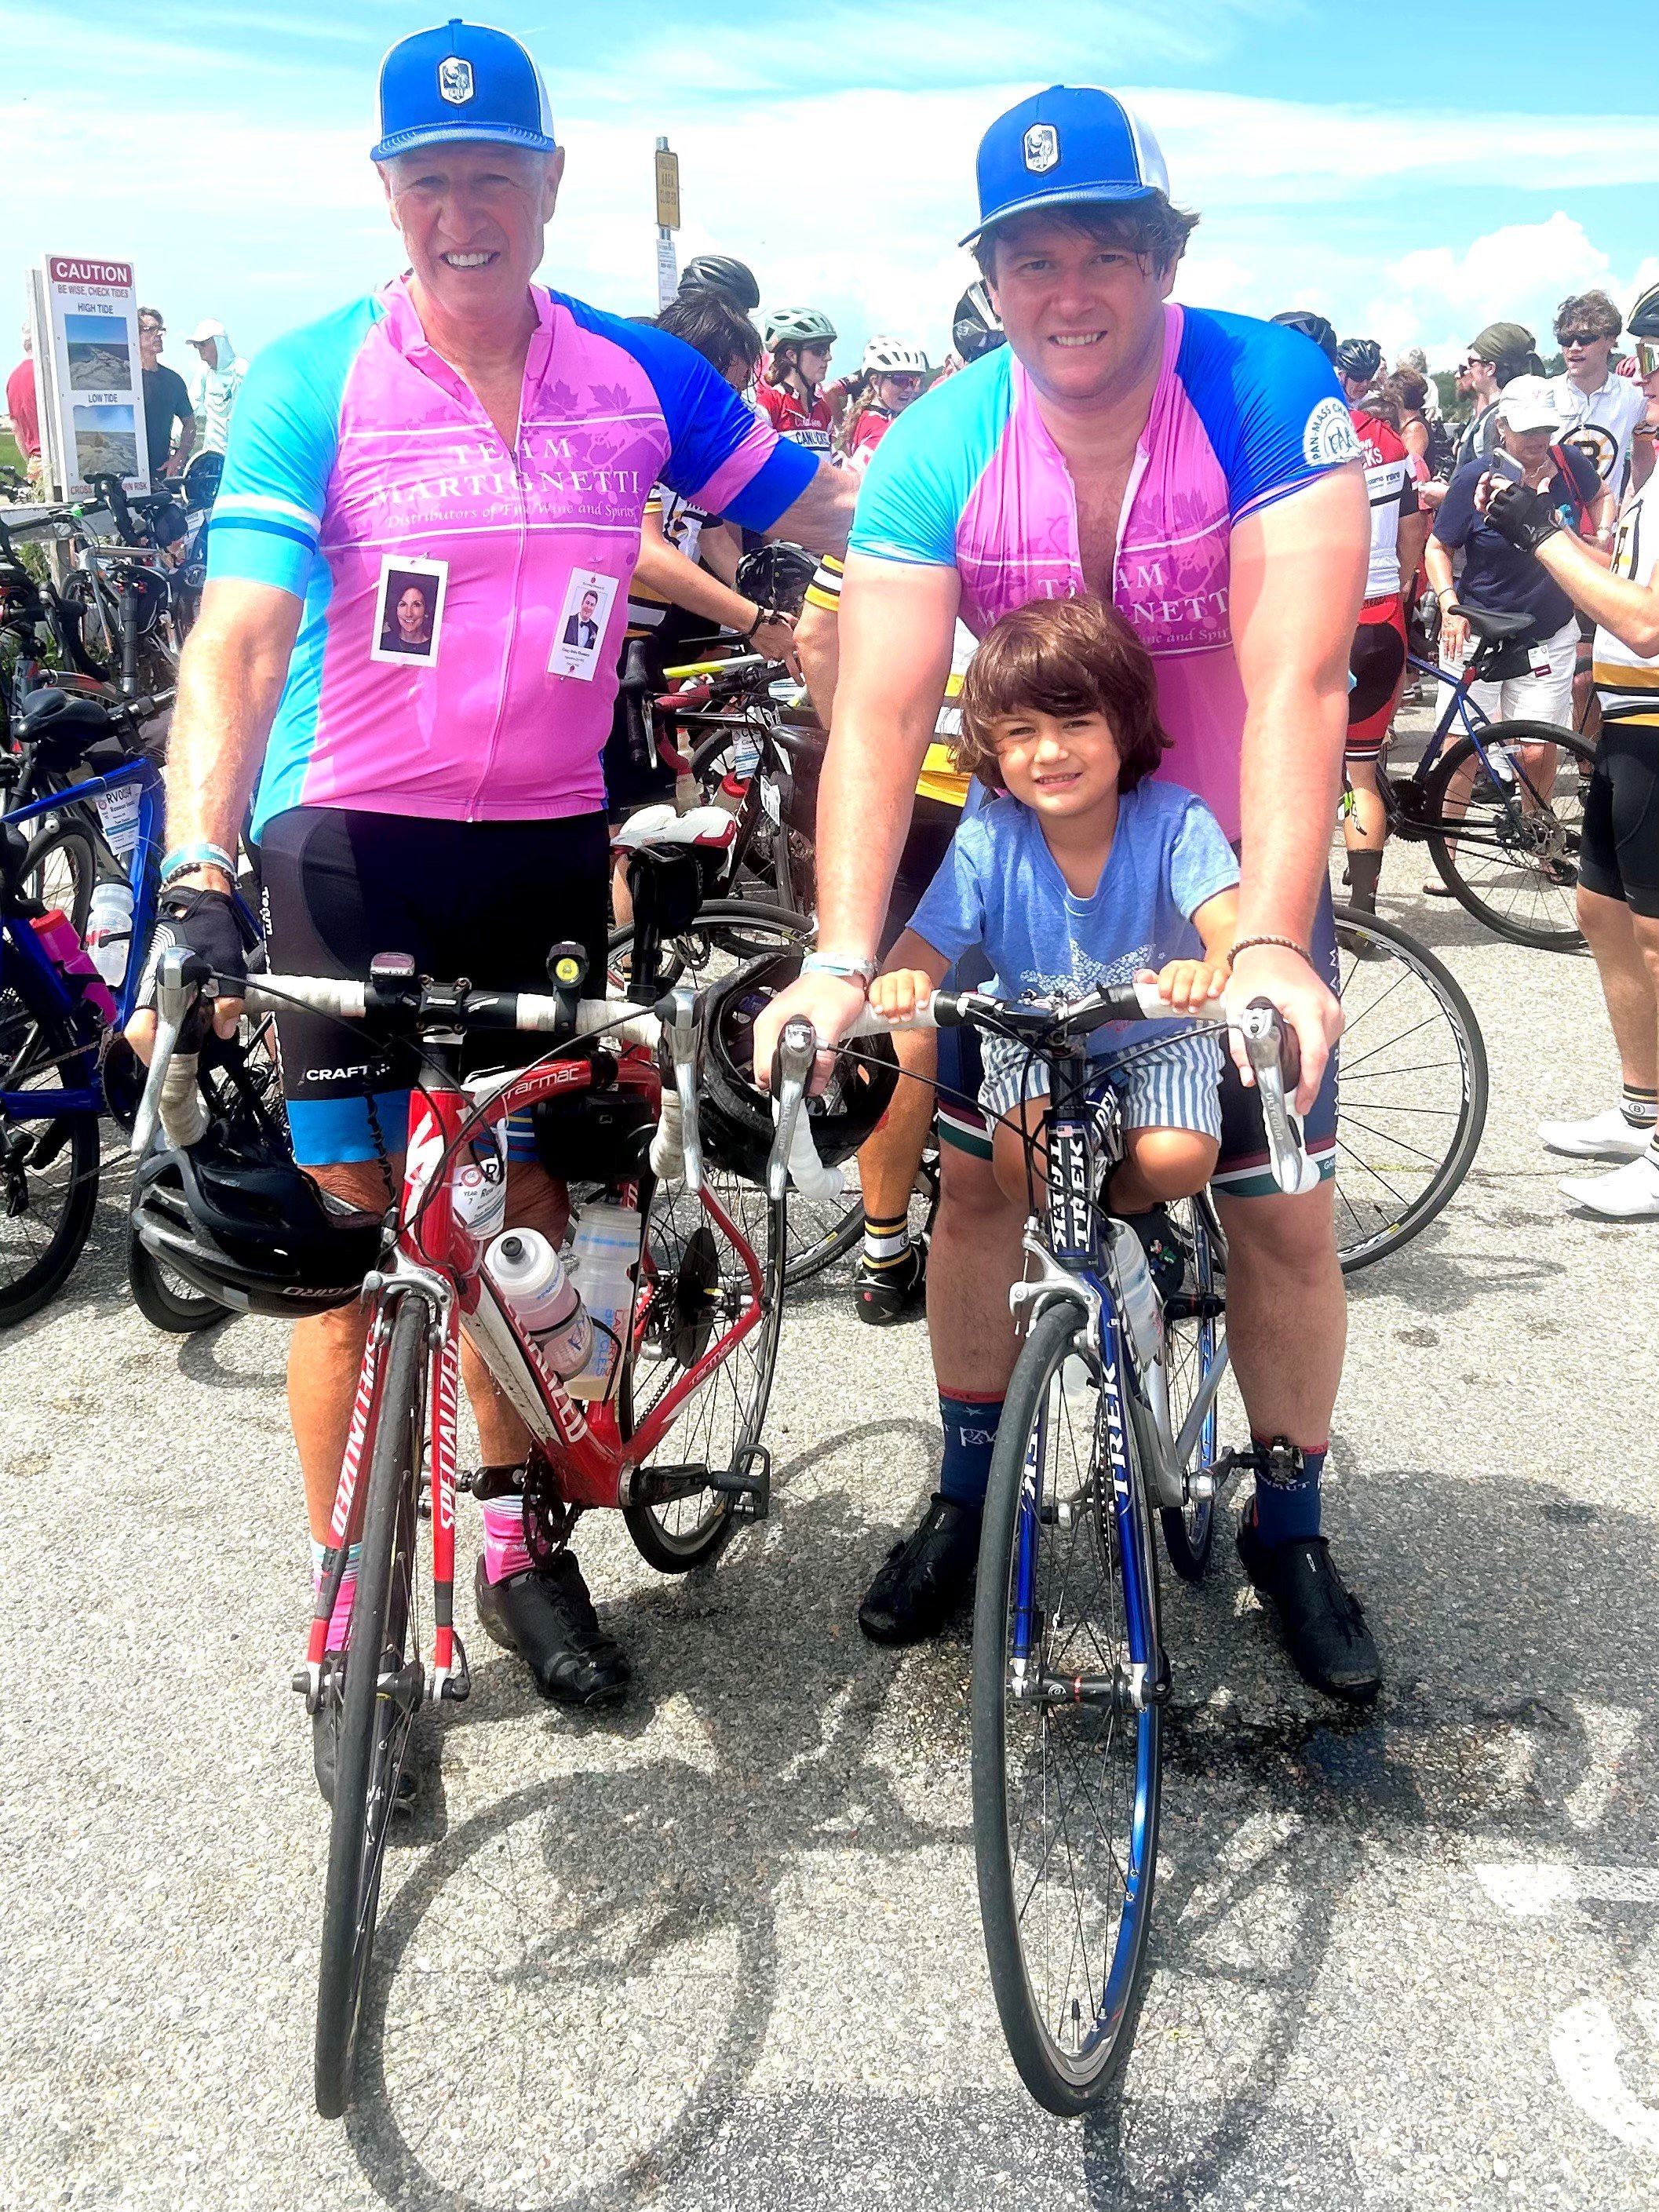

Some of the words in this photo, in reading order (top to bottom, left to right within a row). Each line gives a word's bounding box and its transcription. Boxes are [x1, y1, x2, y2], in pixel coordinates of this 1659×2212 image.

[56, 261, 128, 282] CAUTION
[57, 284, 67, 294] BE
[88, 286, 110, 297] CHECK
[111, 288, 129, 299] TIDES
[78, 302, 95, 313] HIGH
[97, 304, 114, 315] TIDE
[88, 393, 102, 403] LOW
[103, 394, 118, 403] TIDE
[448, 436, 572, 465] TEAM
[70, 485, 93, 495] CROSS
[370, 470, 640, 507] MARTIGNETTI
[385, 508, 477, 529] Distributors
[483, 505, 498, 523] of
[578, 502, 602, 516] and
[605, 503, 636, 523] Spirits
[1167, 628, 1194, 643] and
[306, 1064, 369, 1080] CRAFT
[1050, 1138, 1067, 1250] TREK
[1069, 1139, 1088, 1248] TREK
[283, 1285, 345, 1297] GIRO
[595, 1308, 614, 1378] BICLES
[330, 1334, 377, 1538] SPECIALIZED
[439, 1336, 459, 1531] SPECIALIZED
[1103, 1362, 1129, 1503] TREK
